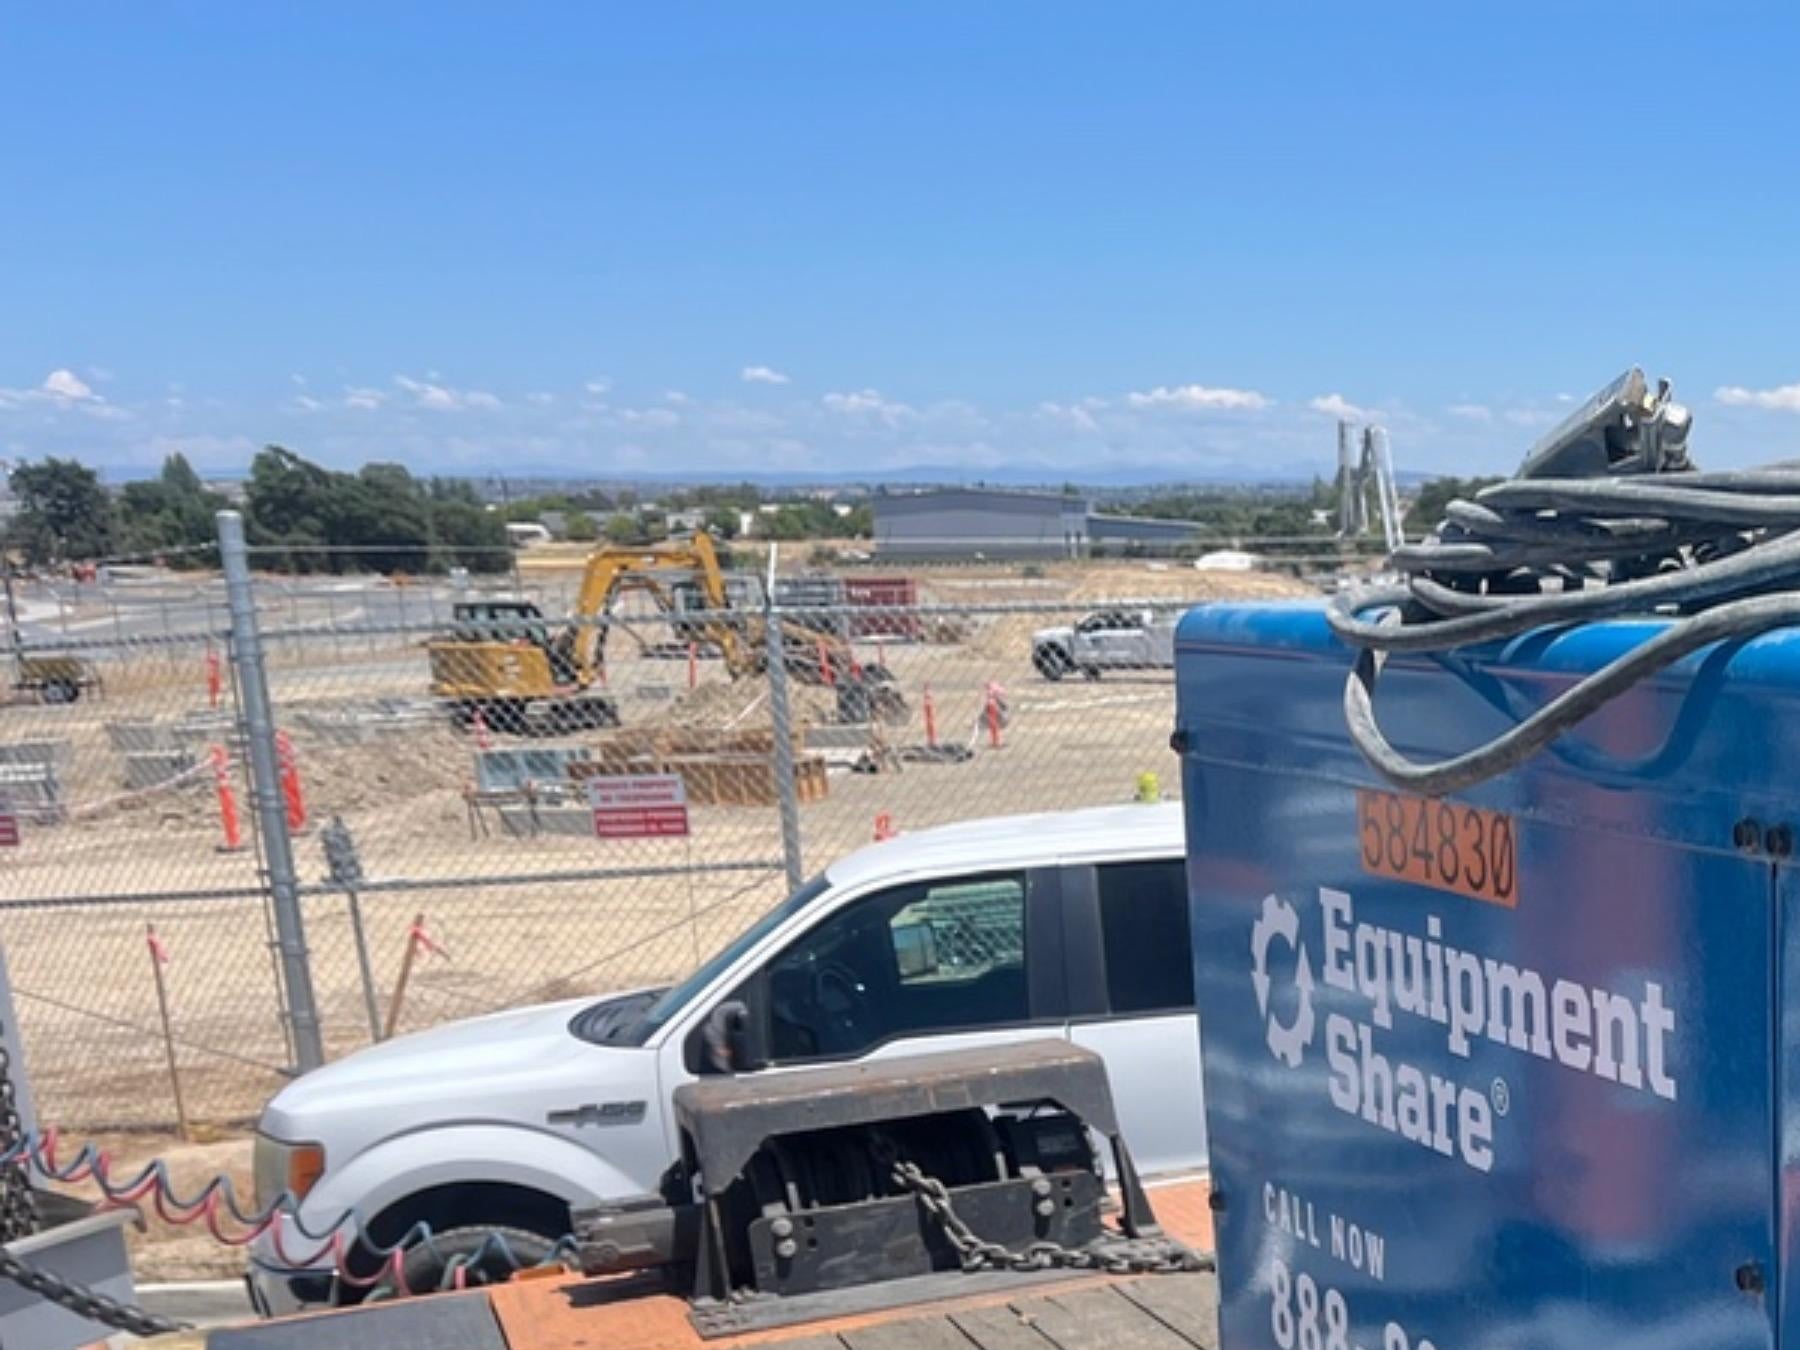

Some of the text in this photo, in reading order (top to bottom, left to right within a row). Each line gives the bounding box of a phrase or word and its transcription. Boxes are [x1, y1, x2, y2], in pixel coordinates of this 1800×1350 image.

[1362, 788, 1514, 899] 584830
[1319, 886, 1677, 1101] Equipment
[1263, 1181, 1385, 1281] CALL NOW
